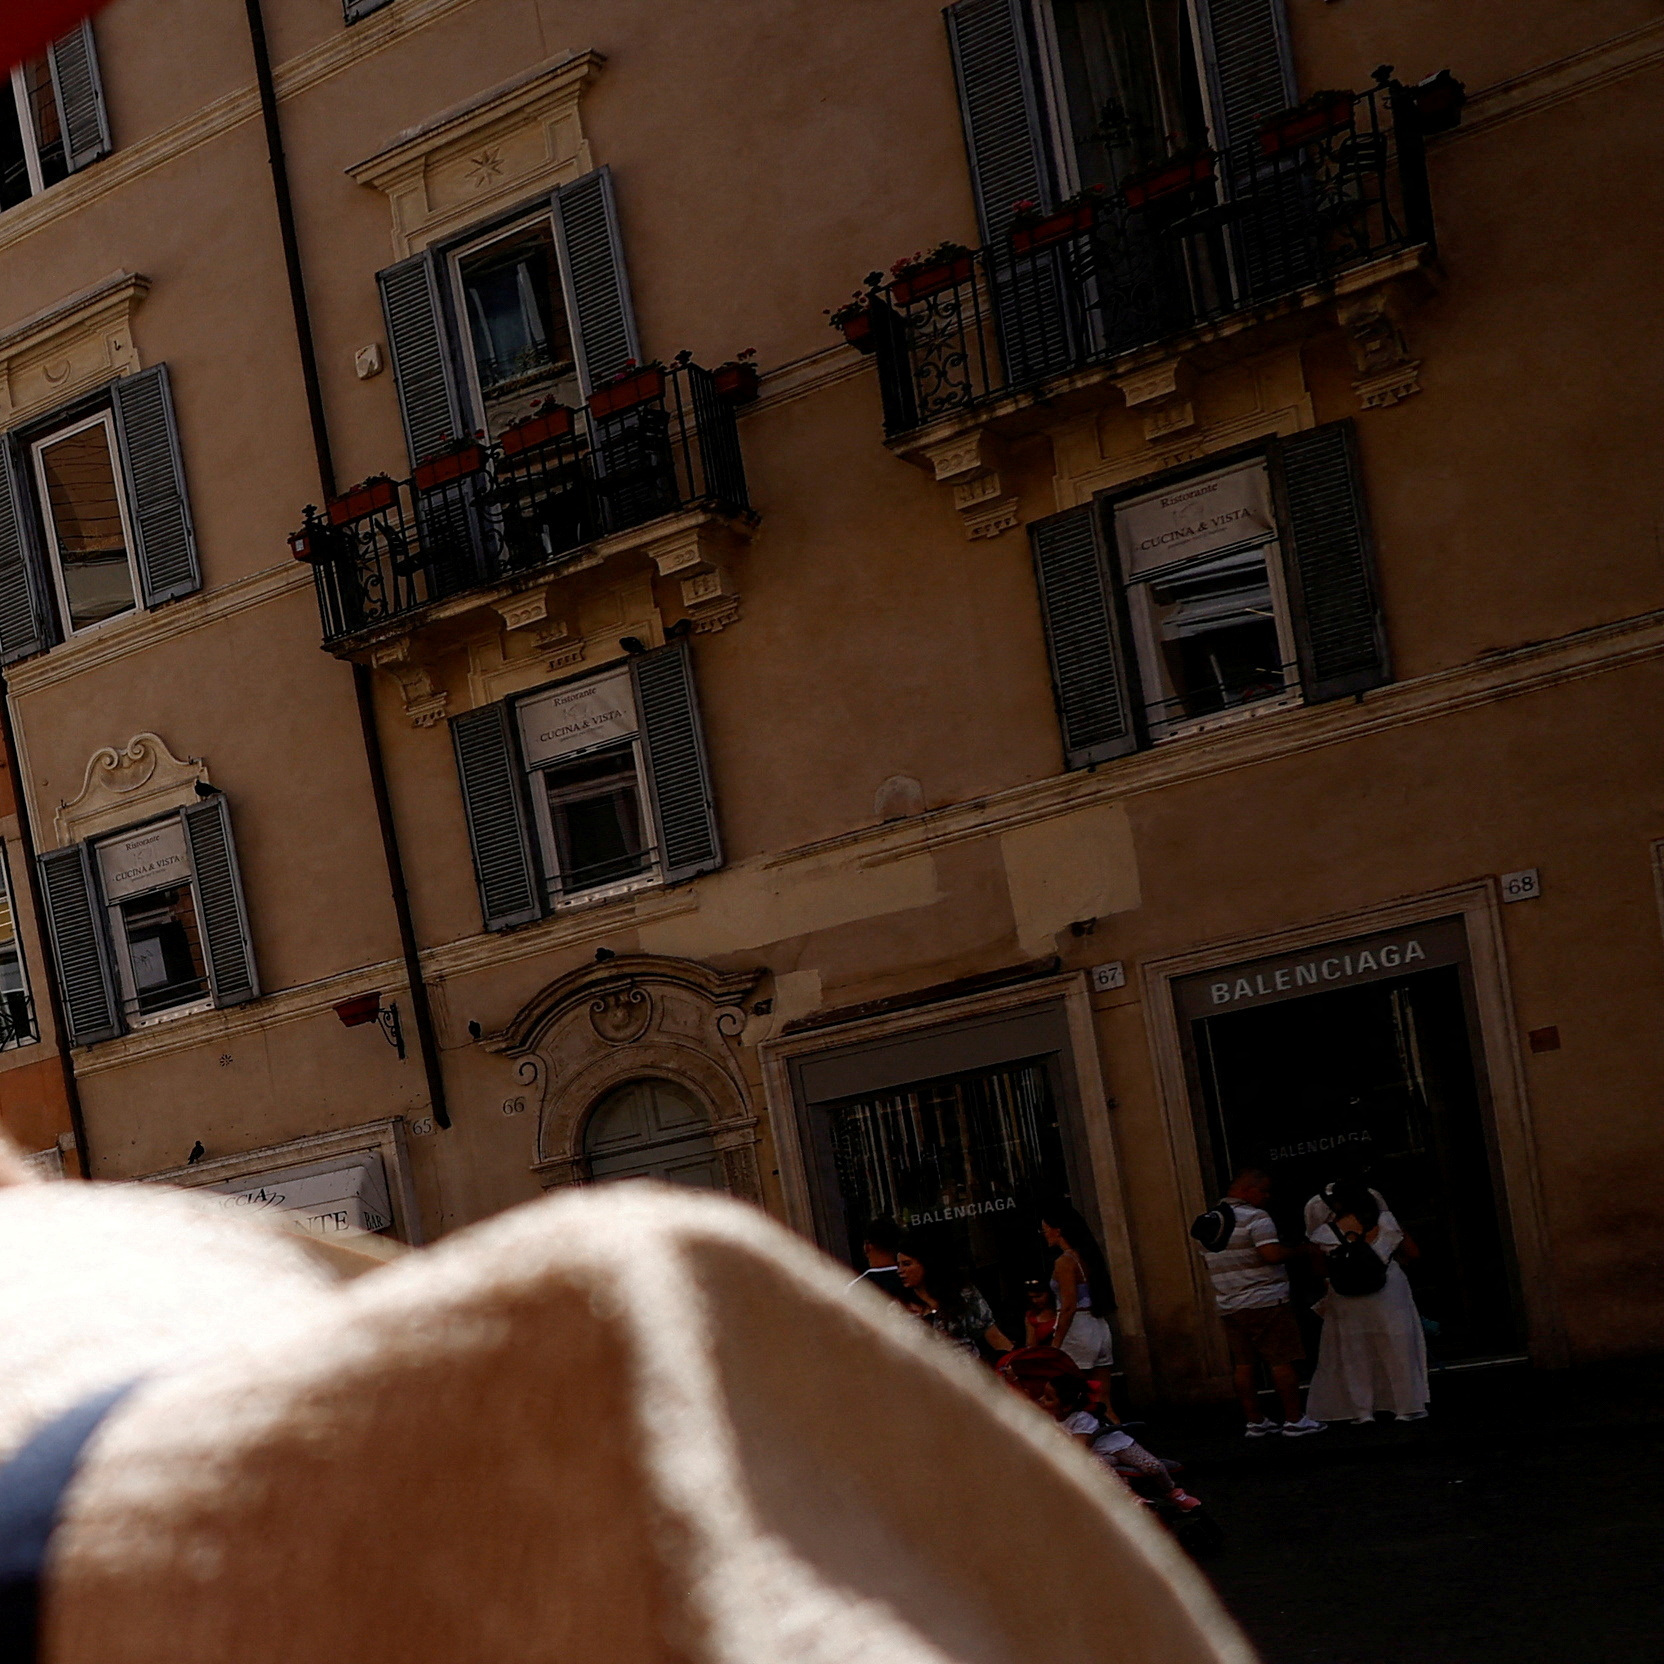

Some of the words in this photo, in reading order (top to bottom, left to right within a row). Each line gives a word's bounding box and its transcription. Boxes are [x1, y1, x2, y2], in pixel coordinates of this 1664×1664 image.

[1161, 483, 1218, 508] Ristorante
[1140, 526, 1195, 551] CUCINA
[1197, 522, 1207, 533] &
[1210, 507, 1251, 528] VISTA
[554, 687, 597, 707] Ristorante
[540, 723, 581, 742] CUCINA
[582, 719, 590, 729] &
[592, 709, 622, 725] VISTA
[125, 835, 160, 851] Ristorante
[115, 866, 148, 882] CUCINA
[148, 864, 155, 872] &
[156, 855, 180, 868] VISTA
[1508, 876, 1534, 894] 68
[1099, 967, 1118, 985] 67
[1211, 940, 1426, 1005] BALENCIAGA
[502, 1096, 525, 1114] 66
[413, 1118, 432, 1135] 65
[364, 1211, 383, 1231] BAR
[912, 1197, 1016, 1226] BALENCIAGA
